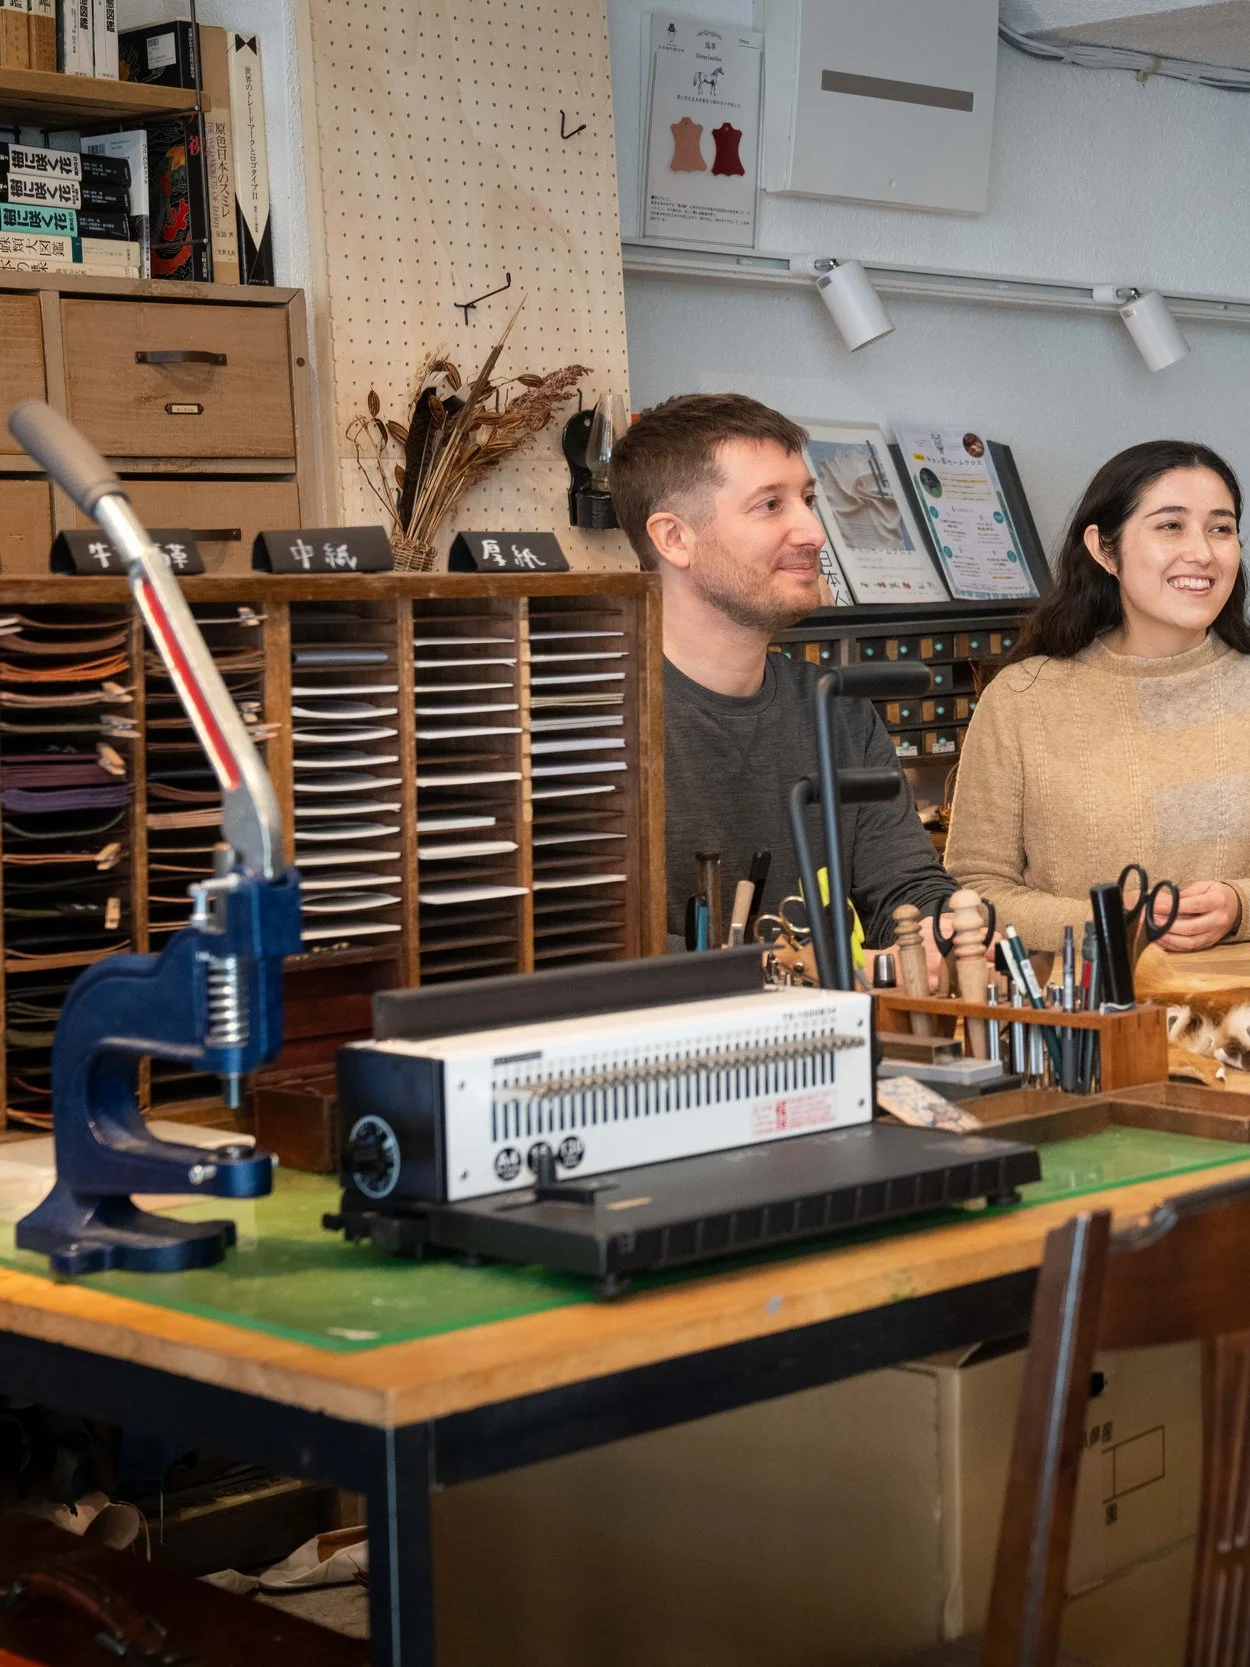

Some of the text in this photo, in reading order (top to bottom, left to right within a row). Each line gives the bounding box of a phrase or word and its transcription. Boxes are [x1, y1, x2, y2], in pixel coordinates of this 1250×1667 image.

[11, 149, 73, 175] 樹に咲く花
[215, 122, 230, 218] 原色日本のスミレ
[10, 179, 71, 203] 樹に咲く花
[2, 208, 68, 231] 樹に咲く花
[289, 539, 357, 570] 中紙
[482, 539, 547, 569] 厚紙
